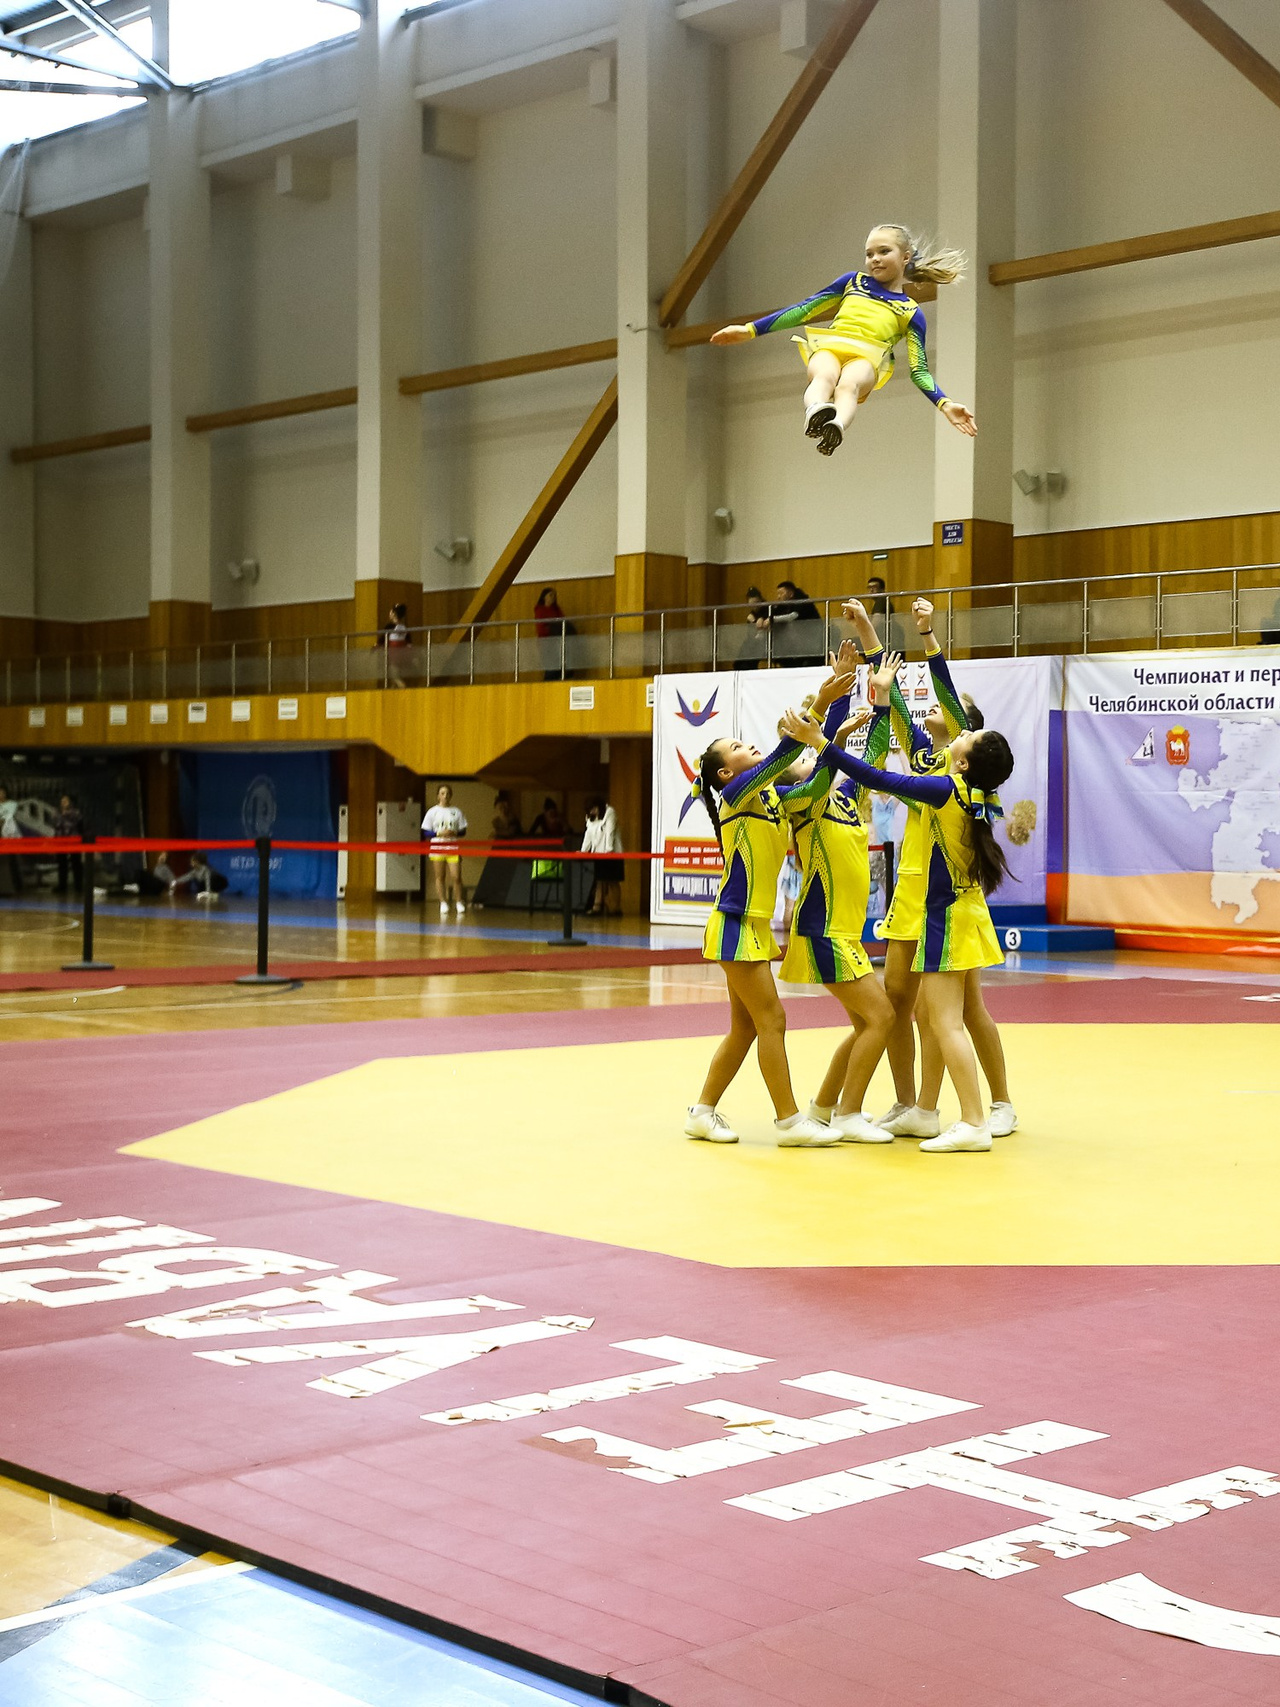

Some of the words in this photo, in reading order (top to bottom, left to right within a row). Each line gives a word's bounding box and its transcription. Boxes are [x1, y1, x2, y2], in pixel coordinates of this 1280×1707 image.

[1133, 667, 1231, 686] Чемпионат
[1235, 670, 1245, 683] и
[1089, 693, 1200, 713] Челябинской
[1203, 692, 1275, 711] области
[1009, 931, 1017, 946] 3
